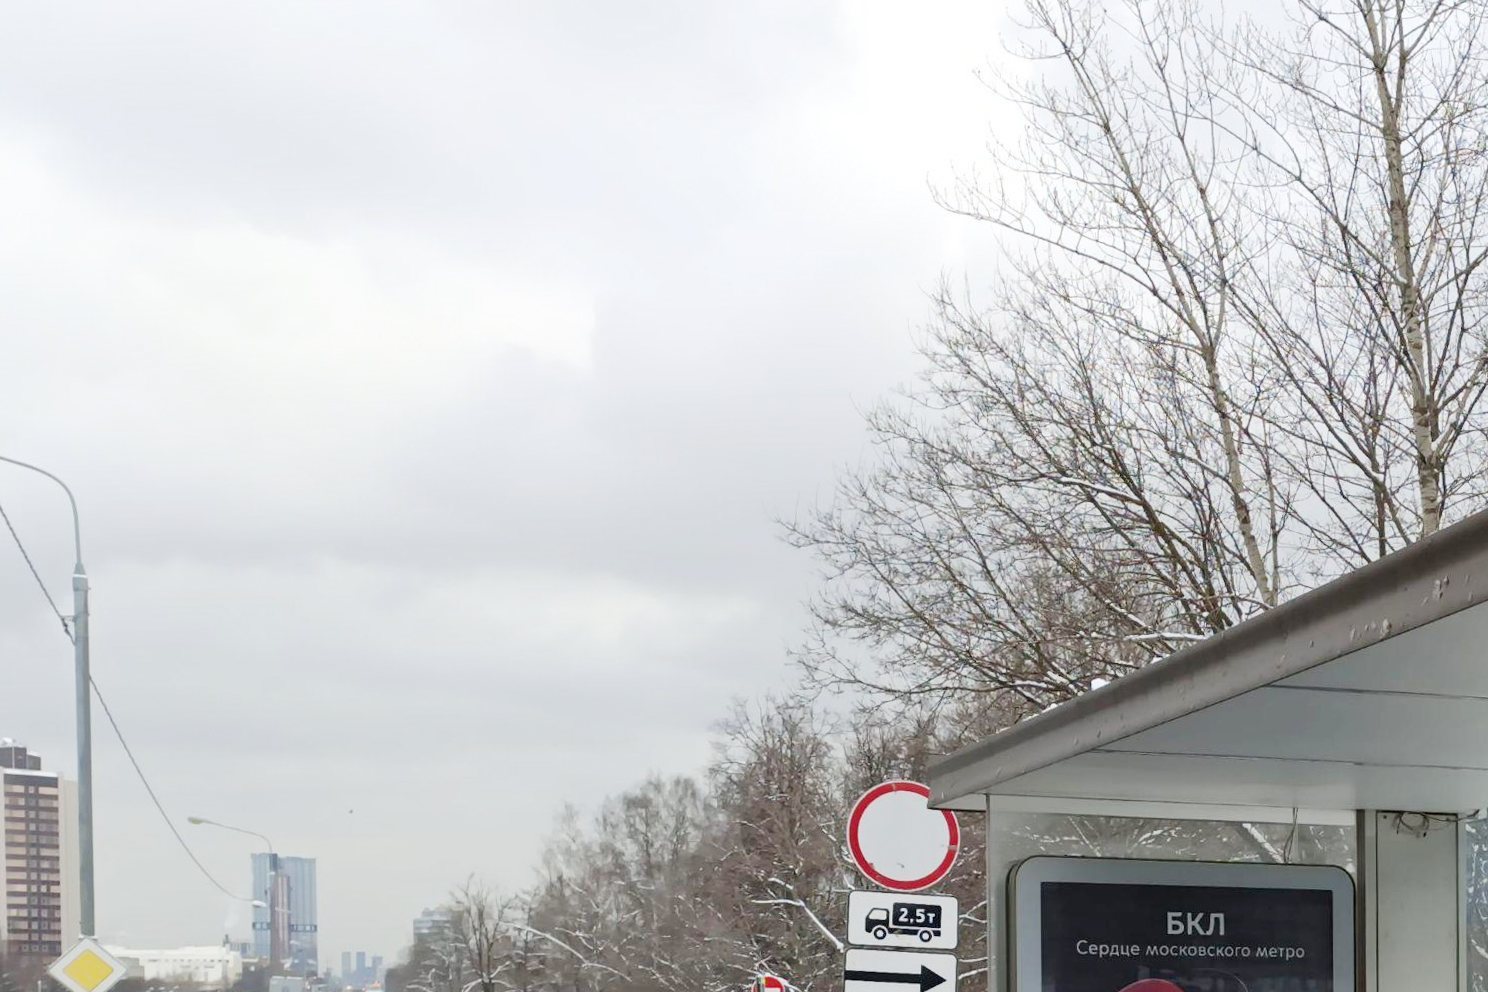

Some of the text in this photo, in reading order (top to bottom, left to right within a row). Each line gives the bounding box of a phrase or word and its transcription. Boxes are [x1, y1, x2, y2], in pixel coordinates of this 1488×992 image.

[1166, 911, 1225, 936] БКЛ
[1076, 939, 1305, 961] Сердце московского метро
